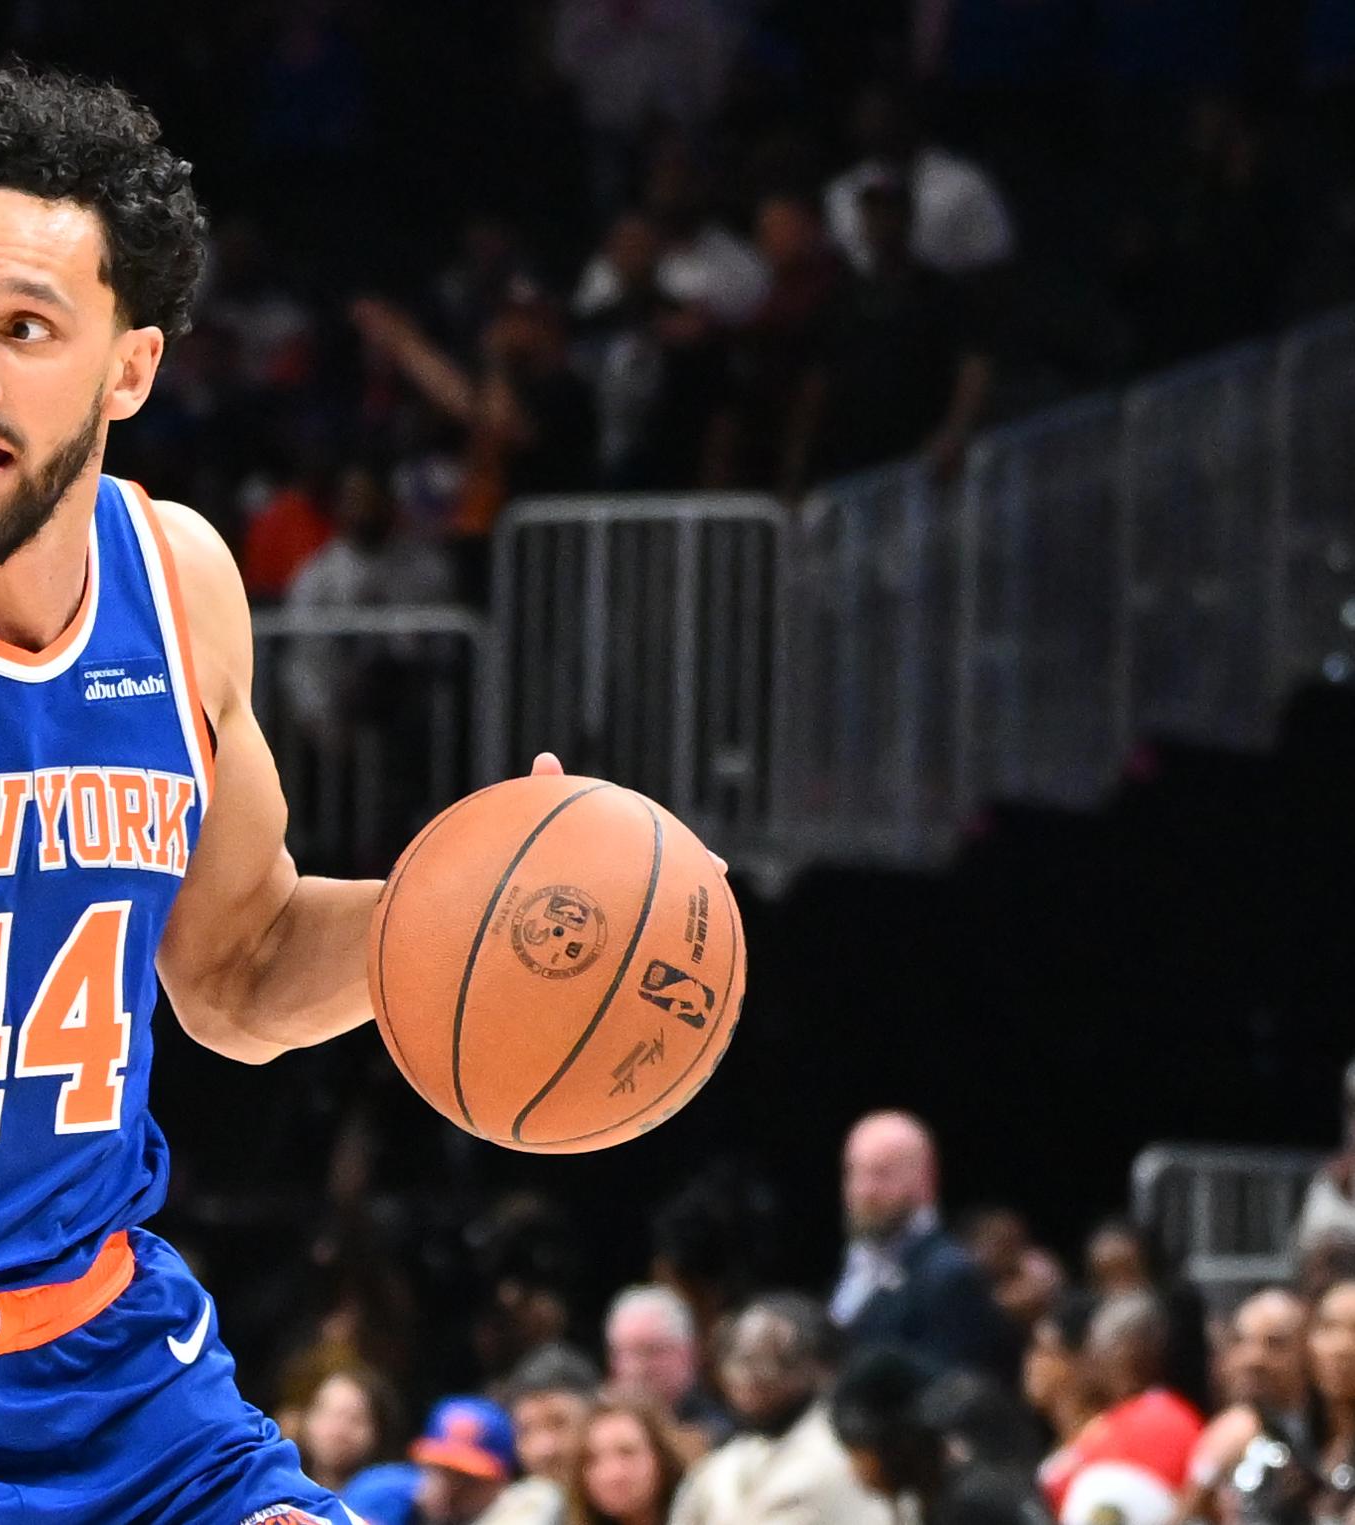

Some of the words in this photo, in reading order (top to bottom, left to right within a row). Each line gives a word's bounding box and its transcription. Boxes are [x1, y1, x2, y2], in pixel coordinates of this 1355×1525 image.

[85, 680, 117, 700] abu
[117, 673, 166, 698] dhabi
[34, 766, 196, 878] YORK
